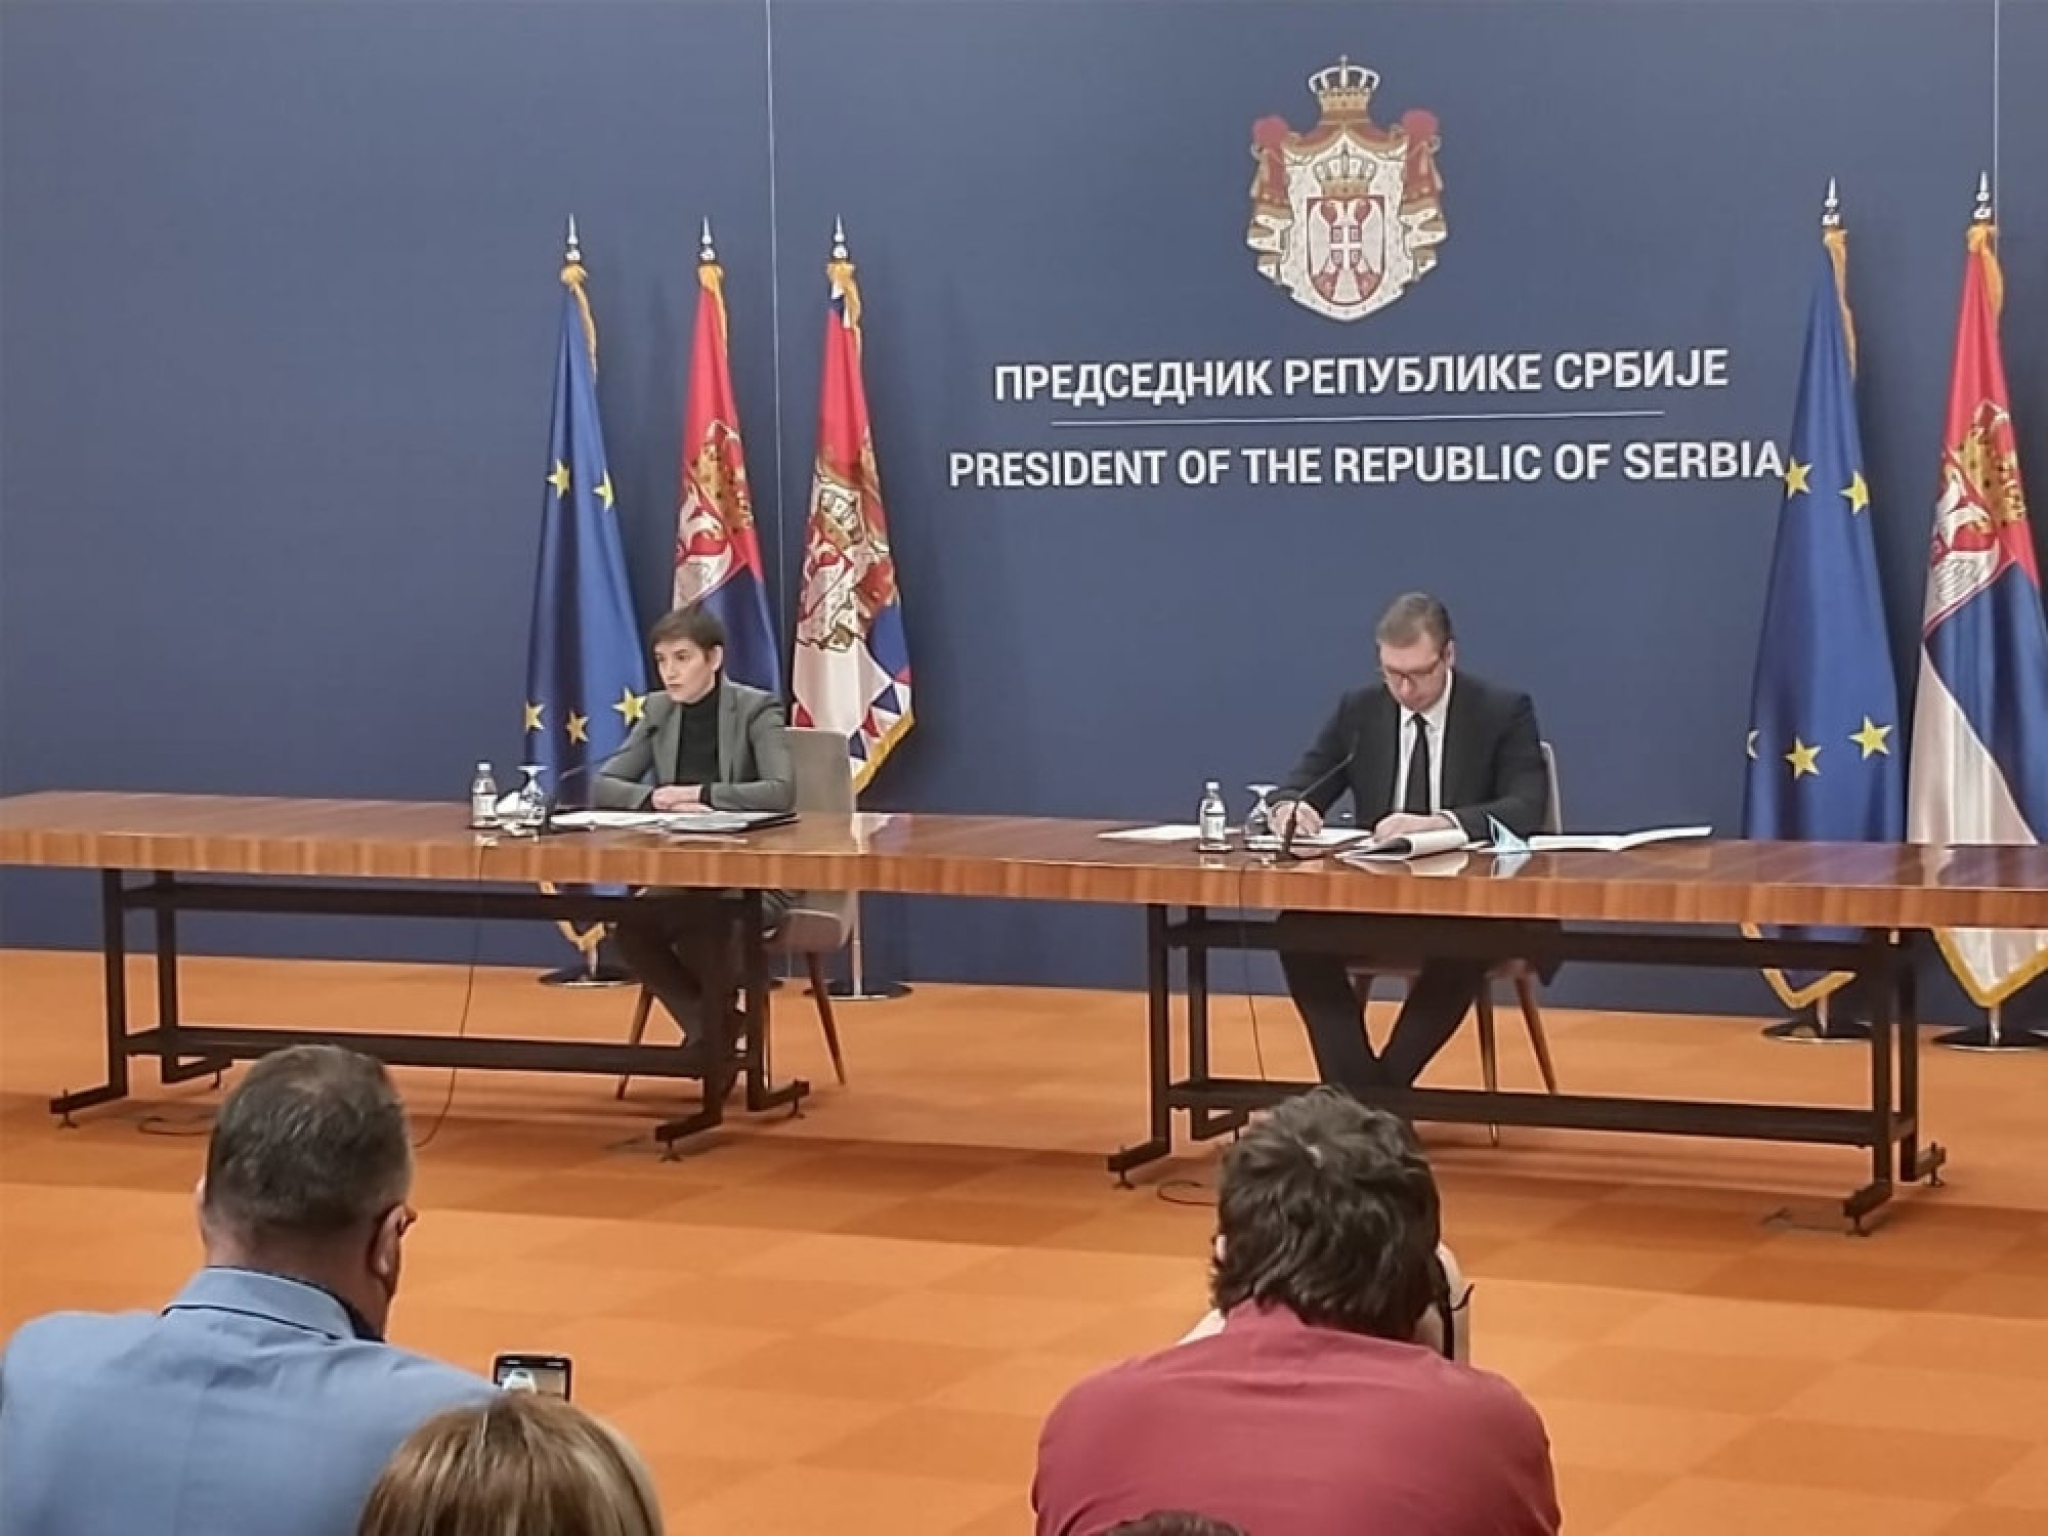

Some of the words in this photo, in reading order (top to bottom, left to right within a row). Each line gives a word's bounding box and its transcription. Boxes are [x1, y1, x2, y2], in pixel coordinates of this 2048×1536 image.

[994, 359, 1273, 407] ПРЕДСЕДНИК
[1284, 353, 1543, 395] РЕПУБЛИКЕ
[1554, 349, 1729, 390] СРБИЈЕ
[949, 450, 1167, 487] PRESIDENT
[1178, 449, 1231, 485] OF
[1241, 447, 1322, 484] THE
[1334, 444, 1542, 483] REPUBLIC
[1554, 443, 1611, 480] OF
[1623, 440, 1785, 480] SERBIA
